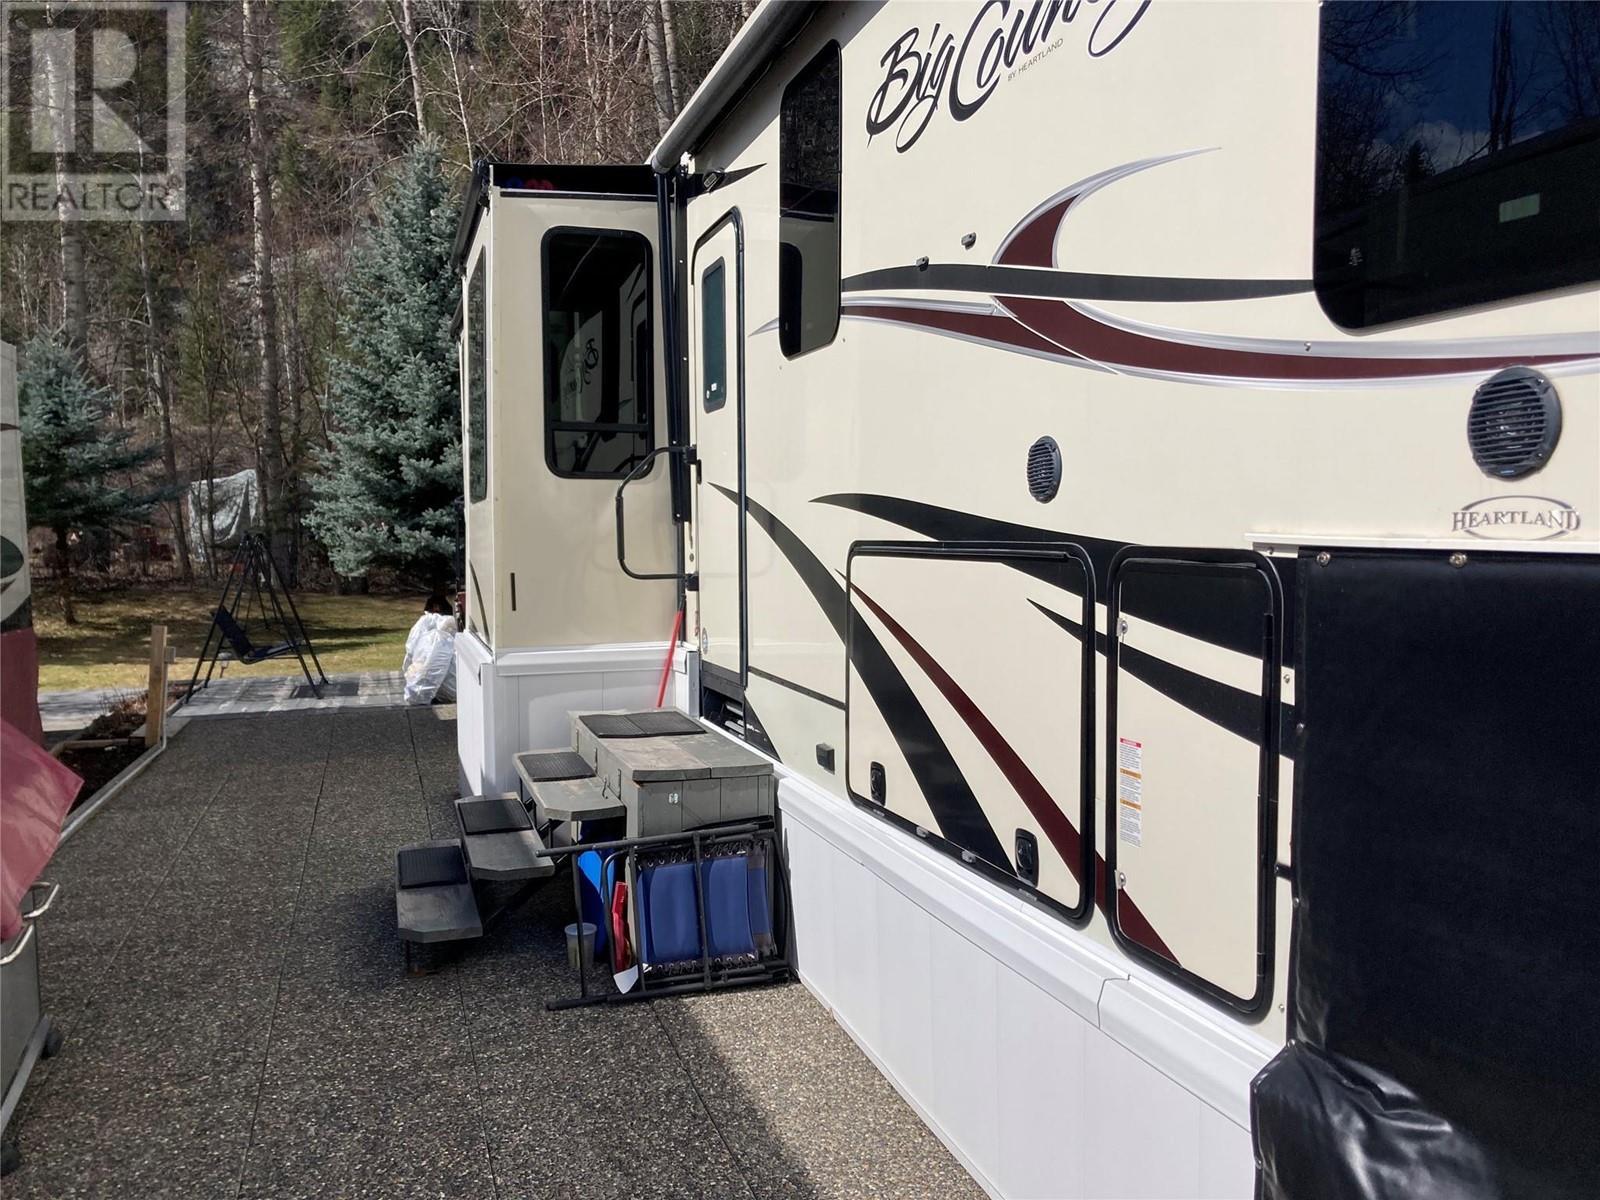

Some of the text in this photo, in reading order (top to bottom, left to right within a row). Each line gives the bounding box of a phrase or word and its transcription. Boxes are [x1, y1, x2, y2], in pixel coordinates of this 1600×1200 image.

[866, 0, 1151, 154] Big Coun
[1007, 37, 1064, 82] BY HEARTLAND
[1451, 510, 1580, 532] HEARTLAND
